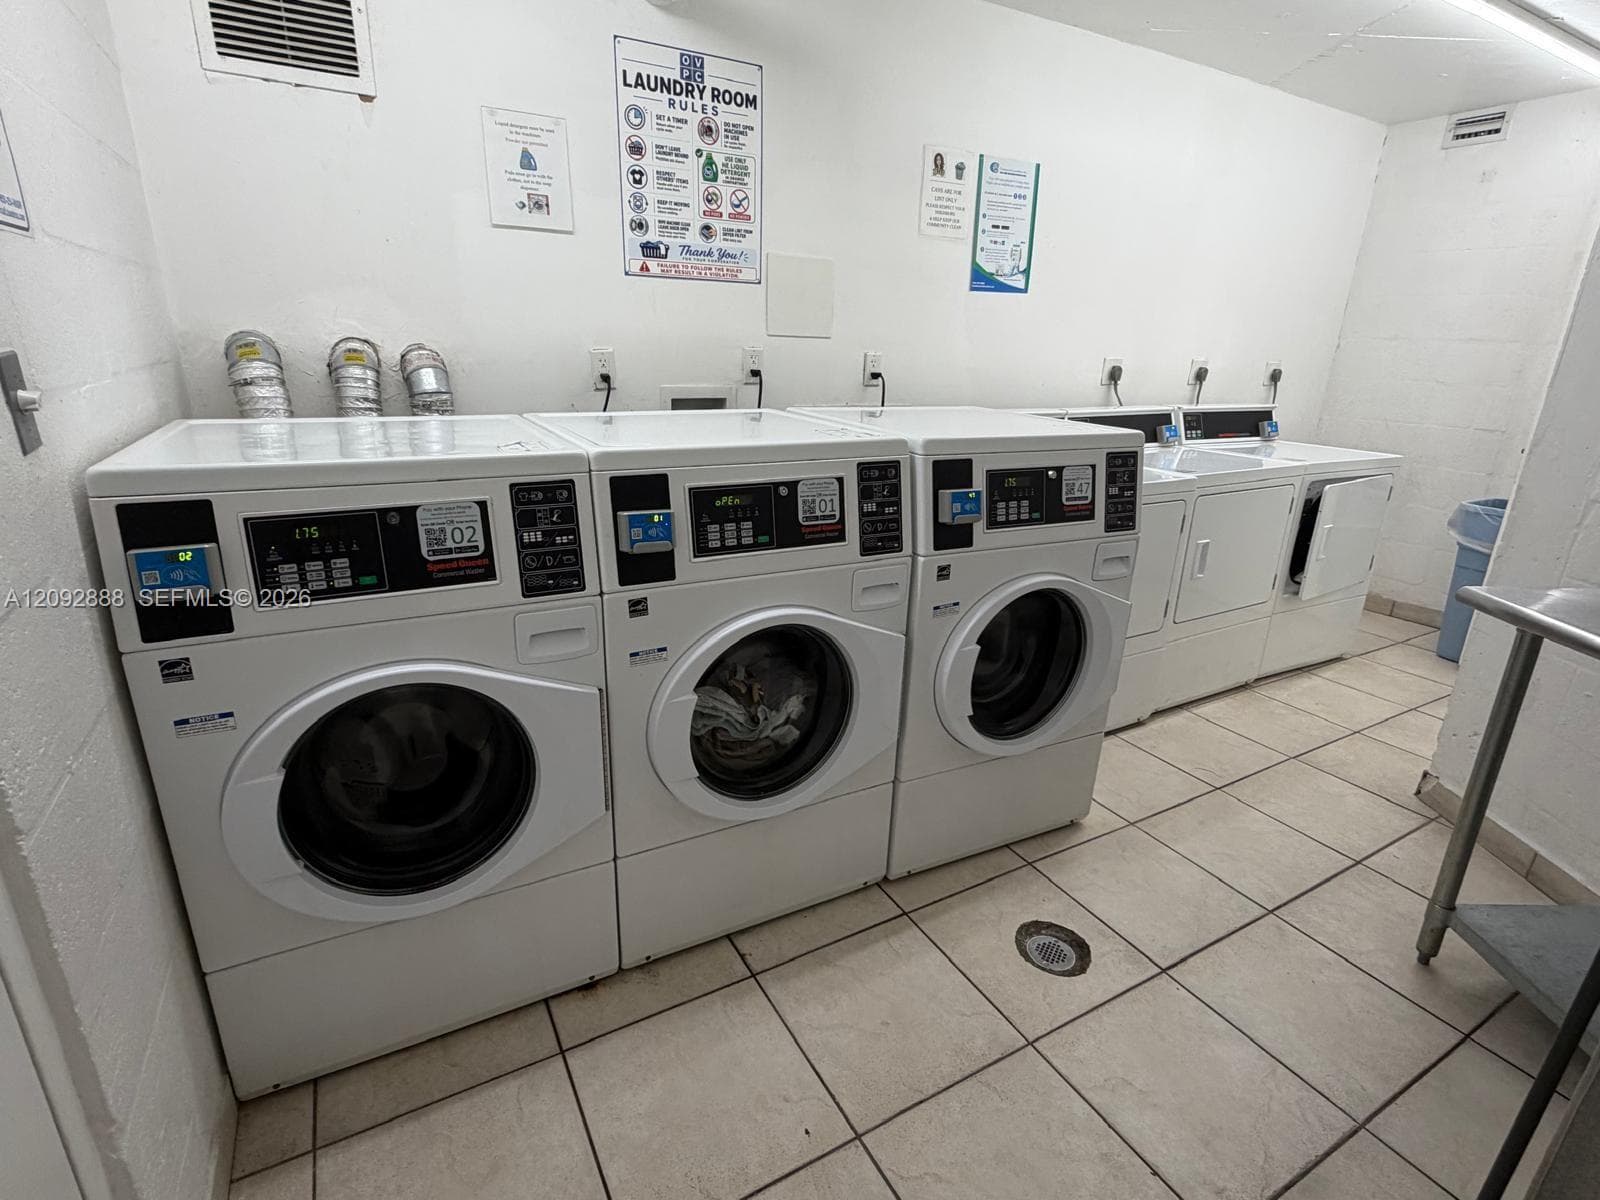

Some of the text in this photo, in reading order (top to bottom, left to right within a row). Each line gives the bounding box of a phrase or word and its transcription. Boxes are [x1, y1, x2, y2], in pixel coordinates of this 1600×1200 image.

[622, 69, 758, 110] LAUNDRY ROOM
[668, 98, 719, 116] RULES
[672, 116, 689, 125] TIMER
[724, 128, 748, 136] MACHINES
[730, 163, 749, 171] LIQUID
[721, 168, 751, 178] DETERGENT
[678, 245, 744, 262] Thank You!
[1077, 482, 1090, 495] 47
[819, 498, 836, 513] 01
[654, 514, 663, 522] 01
[451, 526, 479, 545] 02
[179, 551, 193, 562] 02
[189, 714, 220, 723] NOTICE
